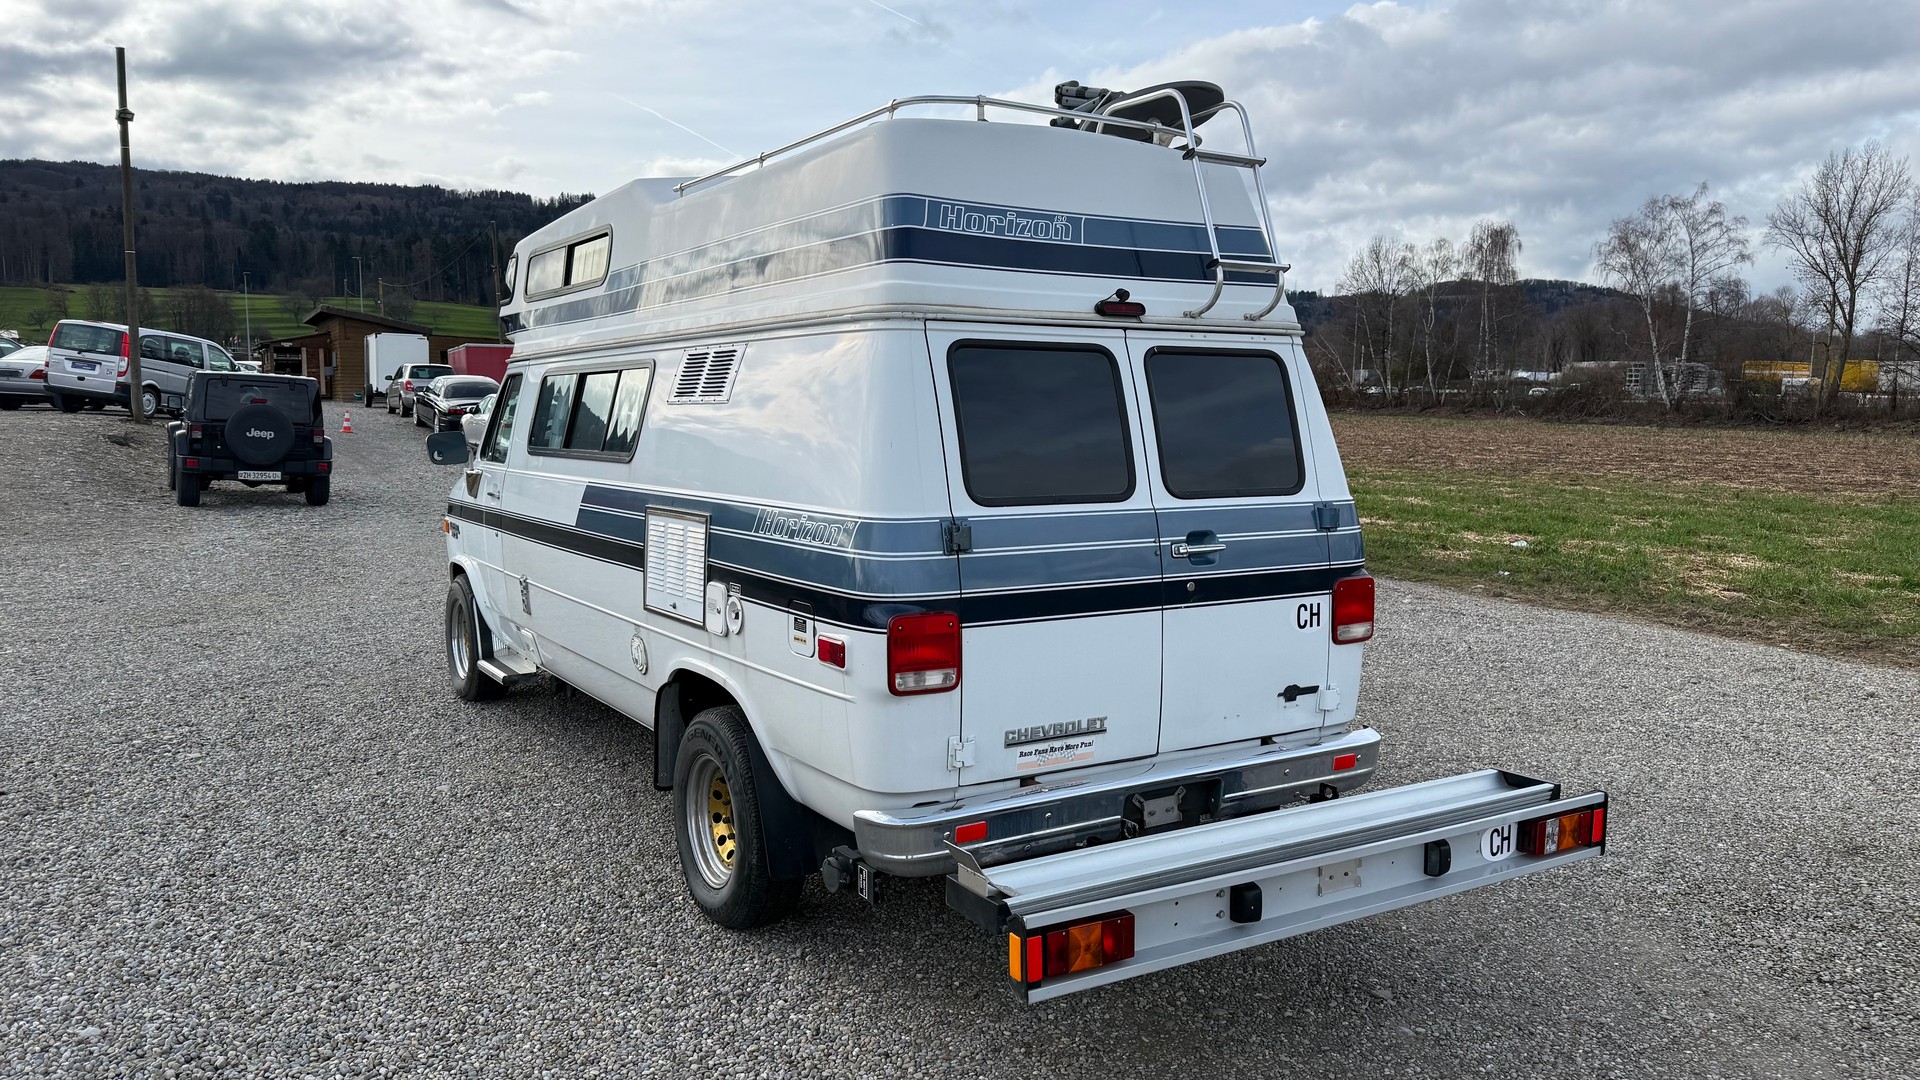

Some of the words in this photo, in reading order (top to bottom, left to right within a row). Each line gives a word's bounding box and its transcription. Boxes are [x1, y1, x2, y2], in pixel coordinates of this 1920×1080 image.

[939, 204, 1072, 240] Horizon
[246, 428, 274, 439] Jeep
[759, 509, 843, 546] Horizon
[1297, 603, 1320, 629] CH
[1004, 716, 1107, 743] CHEVROLET
[1019, 750, 1034, 758] Race
[1034, 748, 1049, 756] Fans
[1049, 745, 1064, 753] Have
[1065, 743, 1079, 751] More
[1080, 740, 1094, 748] Fun!
[1490, 824, 1511, 857] CH
